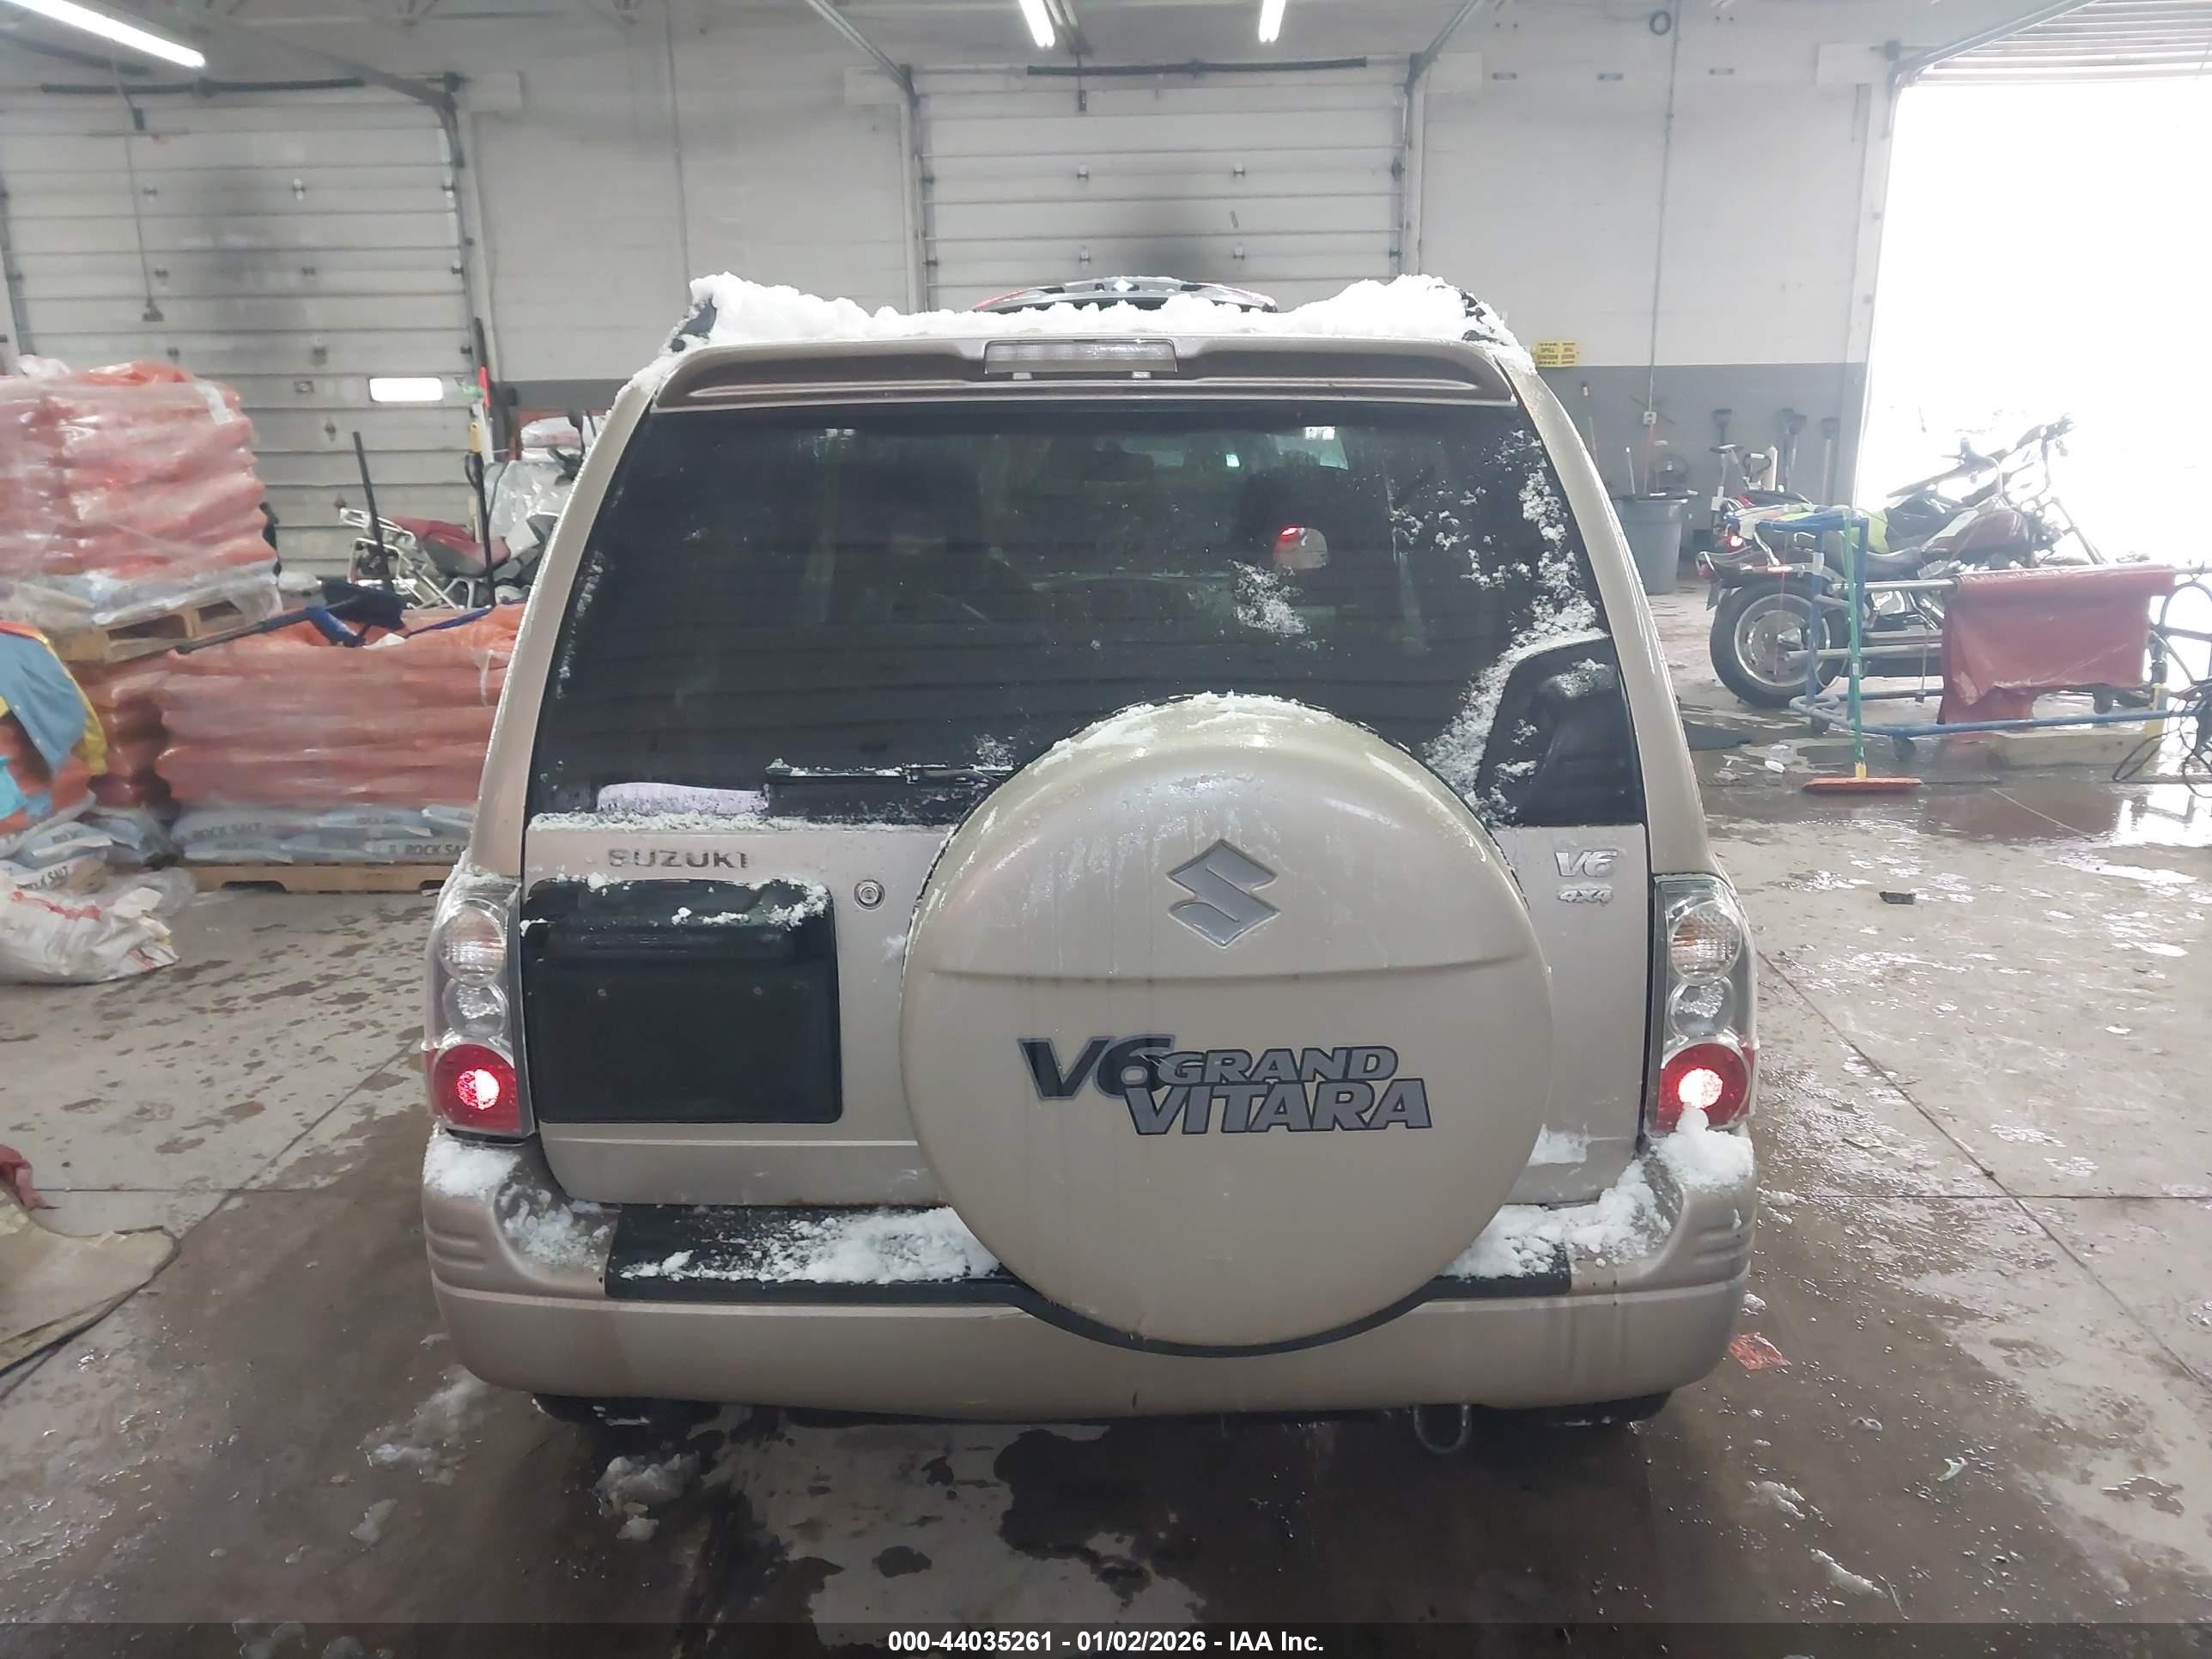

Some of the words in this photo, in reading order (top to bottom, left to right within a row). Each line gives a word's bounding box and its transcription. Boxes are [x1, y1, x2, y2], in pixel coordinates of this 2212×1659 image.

[608, 848, 750, 868] SUZUKI
[1554, 848, 1618, 878] V6
[1017, 1034, 1176, 1100] V6
[1156, 1045, 1399, 1085] GRAND
[1124, 1078, 1433, 1135] VITARA
